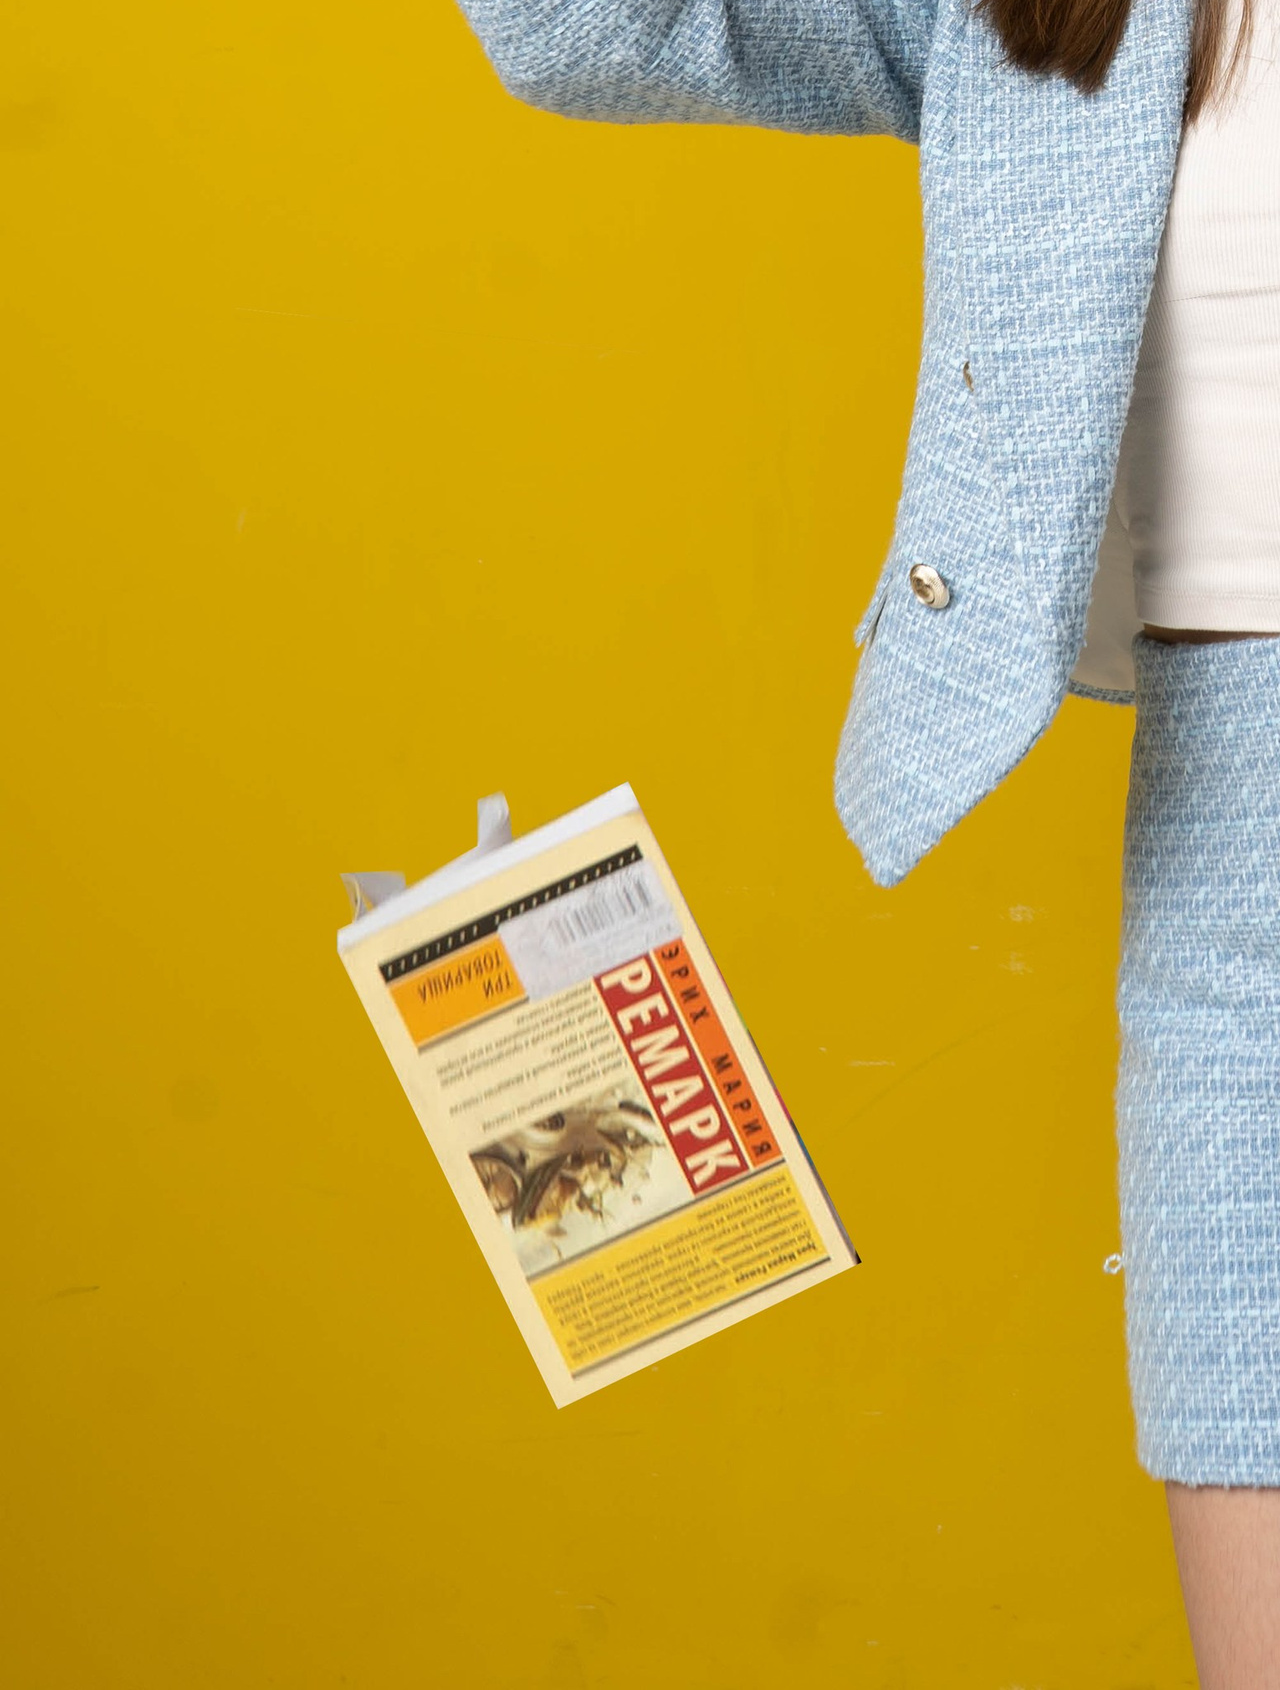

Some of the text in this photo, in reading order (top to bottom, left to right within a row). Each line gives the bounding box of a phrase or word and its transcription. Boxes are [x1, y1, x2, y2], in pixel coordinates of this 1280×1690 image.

[417, 949, 502, 1005] ТОВАРИЩА
[482, 971, 513, 1000] ТРИ
[600, 957, 742, 1188] РЕМАРК
[661, 945, 710, 1024] ЭРИХ
[712, 1053, 773, 1158] МАРИЯ
